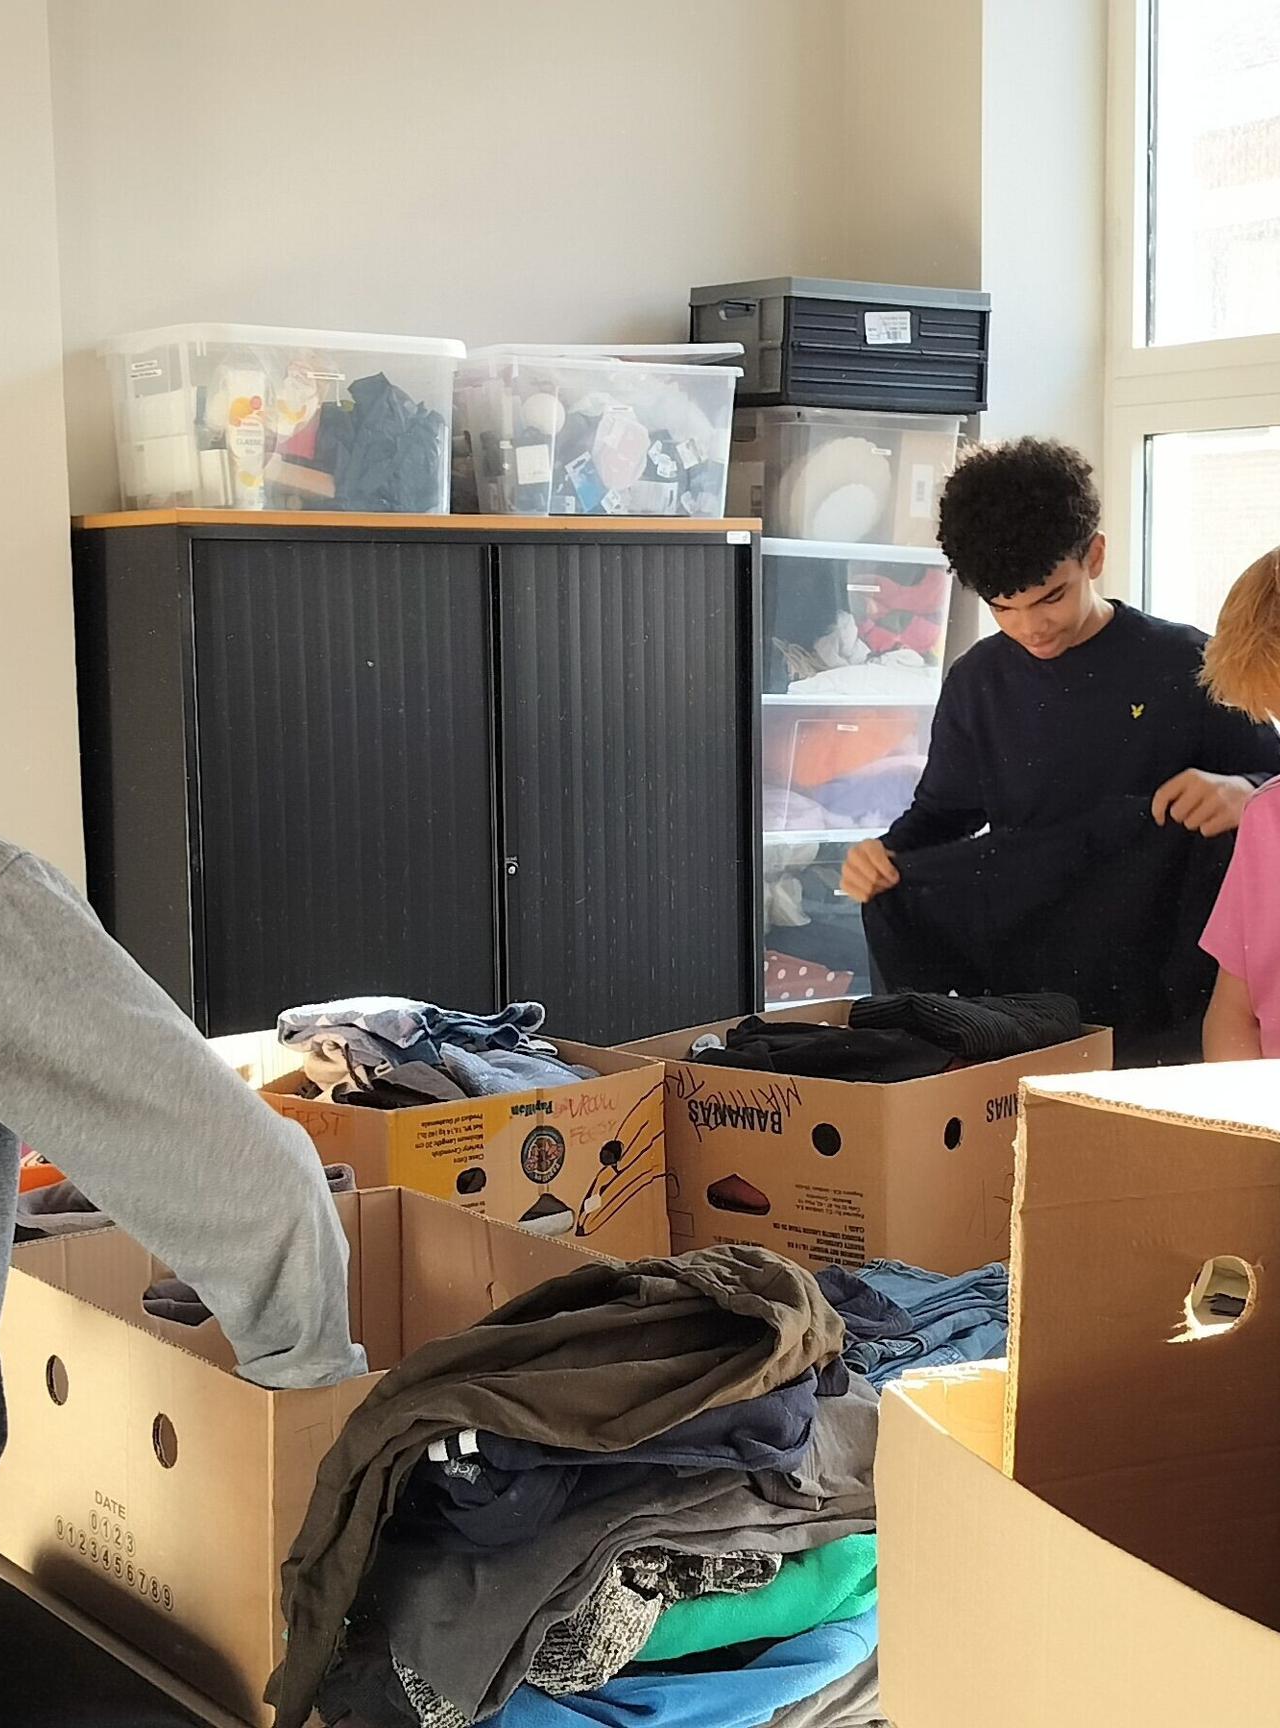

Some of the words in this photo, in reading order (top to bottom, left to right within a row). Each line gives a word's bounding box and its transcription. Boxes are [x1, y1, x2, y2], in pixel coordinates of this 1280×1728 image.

[511, 1100, 553, 1117] Papillon
[687, 1100, 782, 1135] BANANAS
[94, 1489, 127, 1520] DATE
